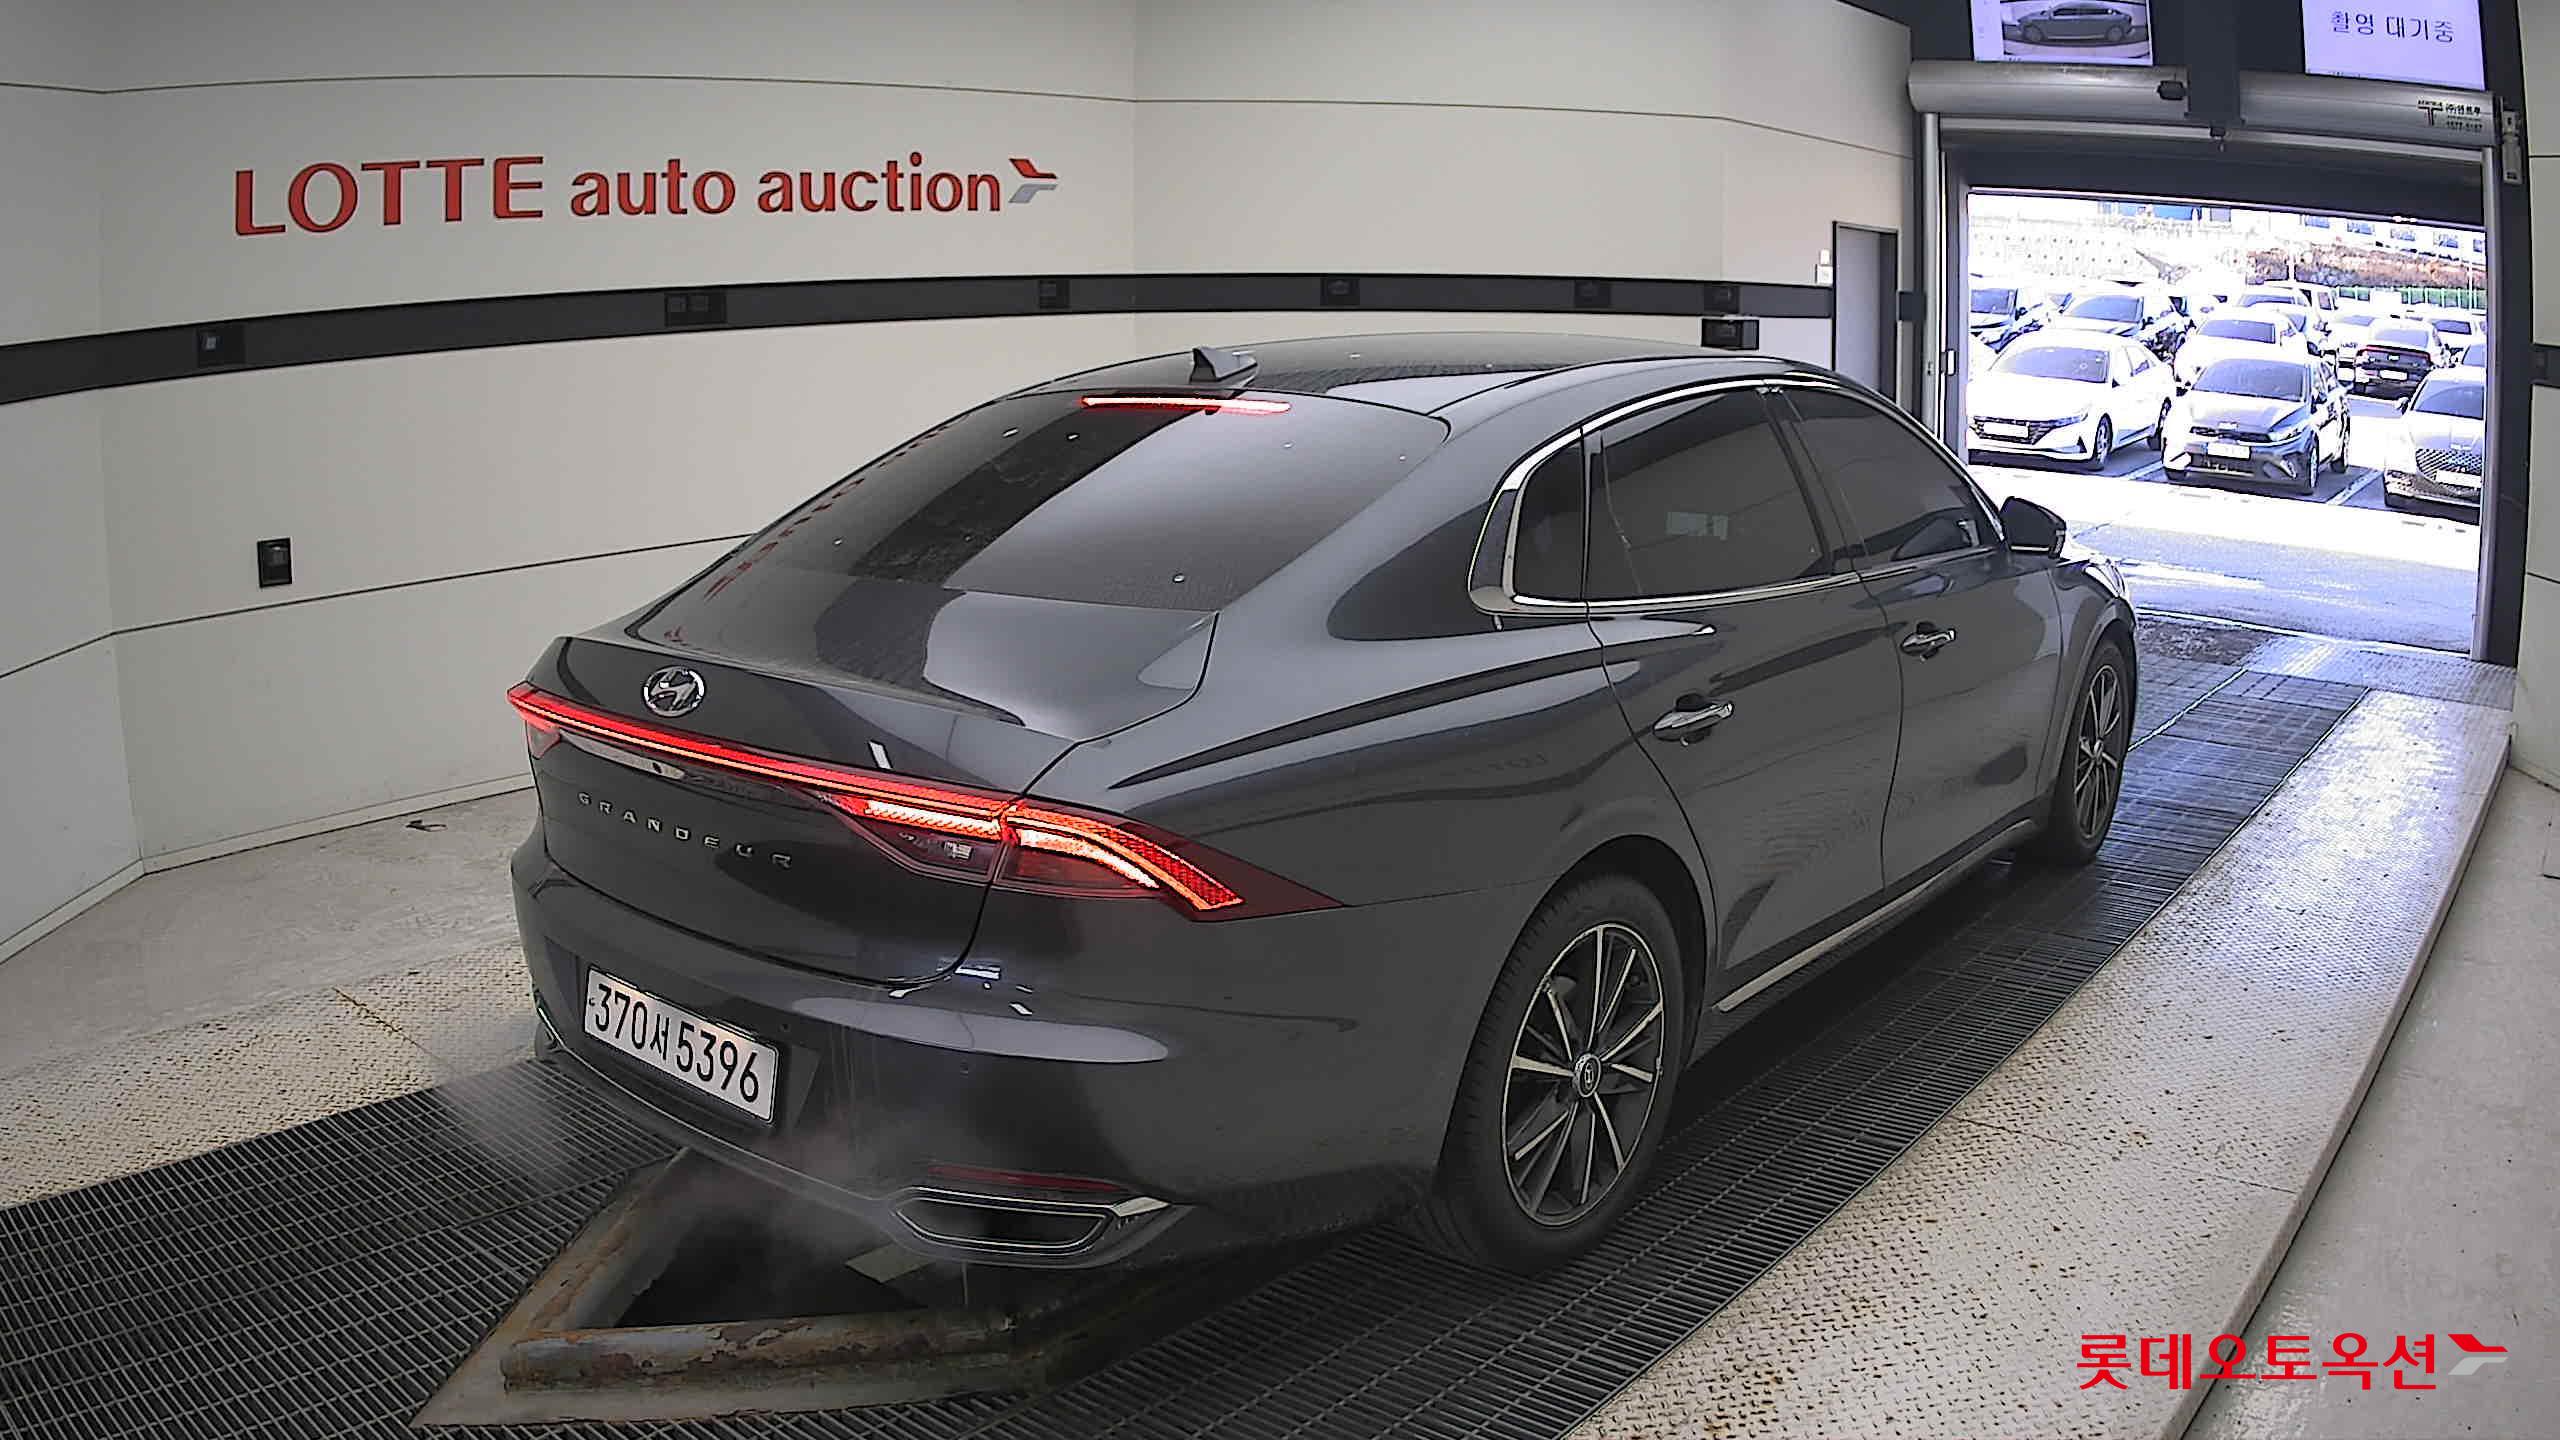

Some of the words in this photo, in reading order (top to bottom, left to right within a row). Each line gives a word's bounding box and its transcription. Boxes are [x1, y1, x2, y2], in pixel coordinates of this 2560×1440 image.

[2331, 10, 2374, 35] 촬영
[2386, 16, 2454, 43] 대기중
[235, 155, 544, 236] LOTTE
[570, 158, 737, 216] auto
[757, 151, 1001, 213] auction
[577, 791, 793, 870] GRANDEUR
[595, 983, 760, 1104] 370서5396
